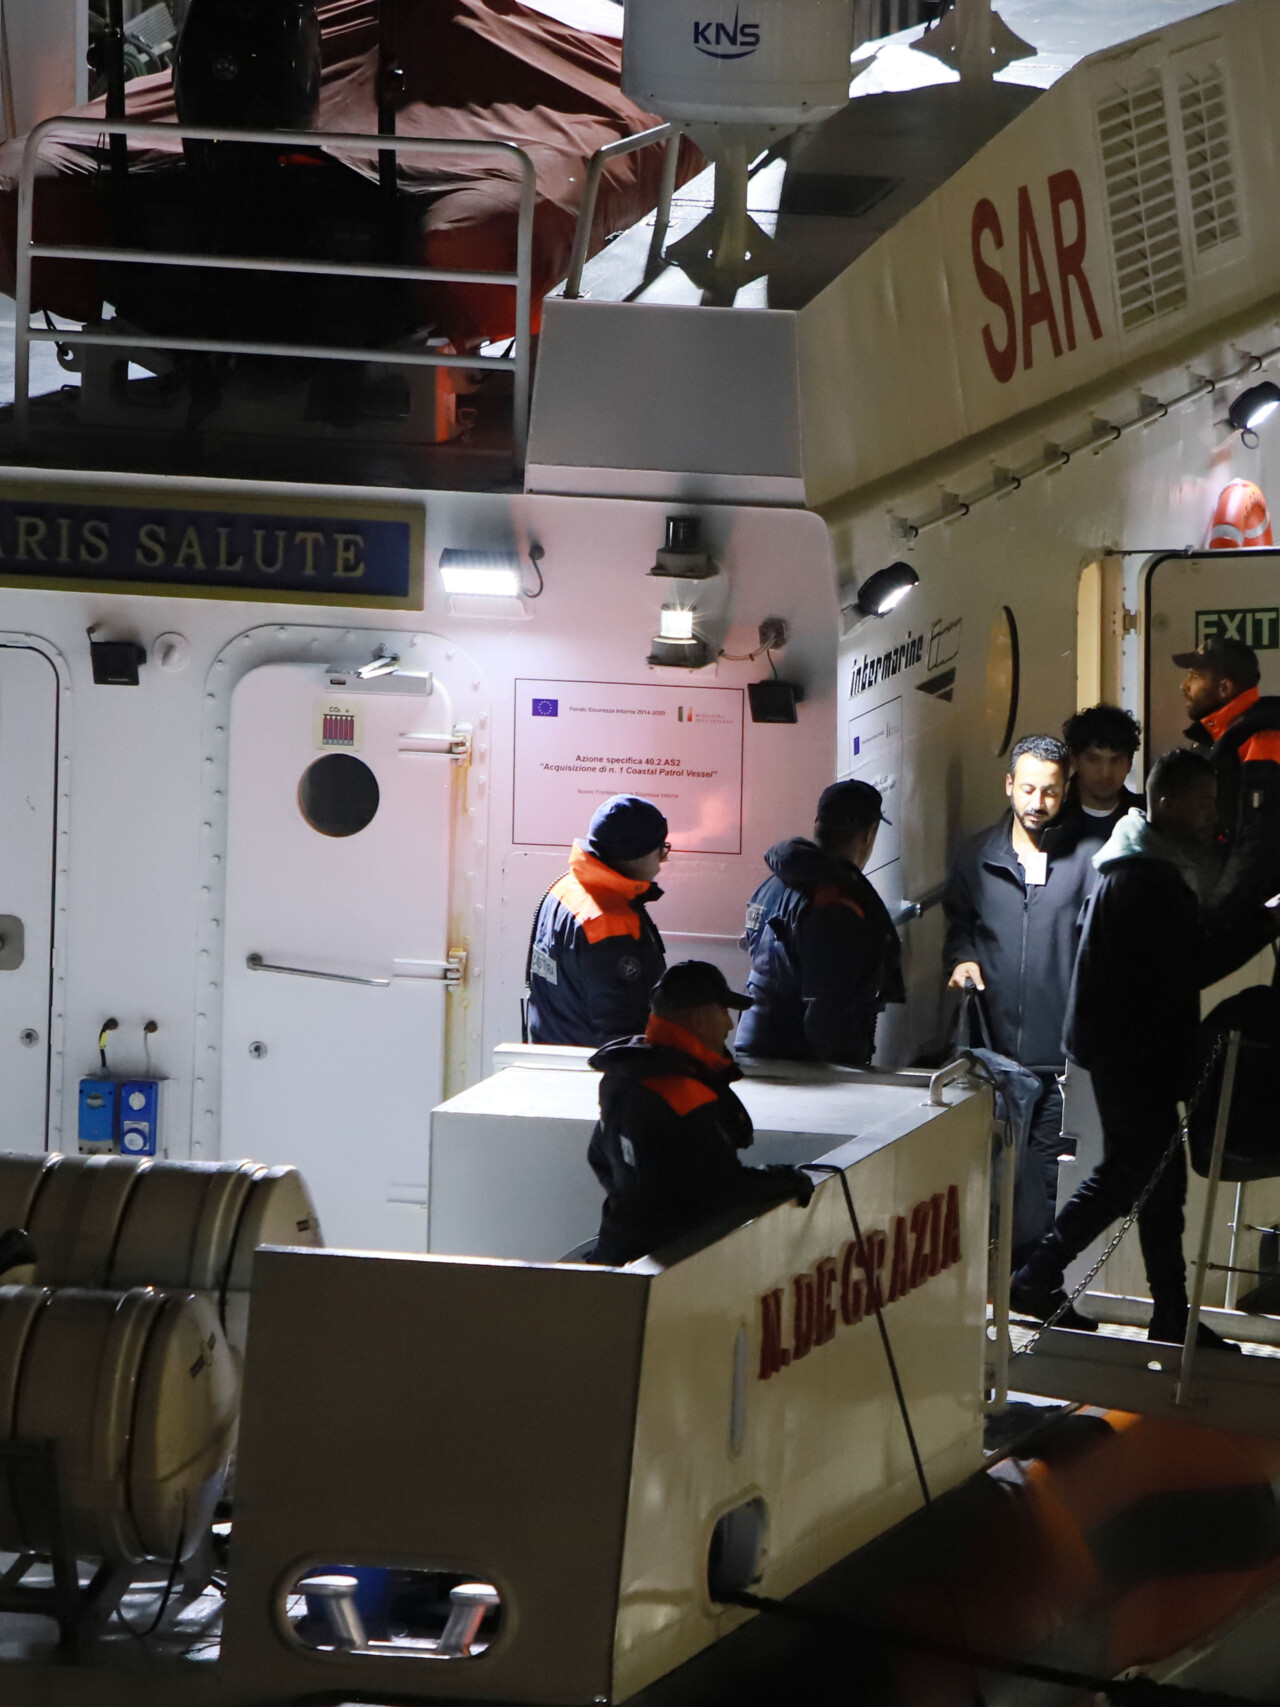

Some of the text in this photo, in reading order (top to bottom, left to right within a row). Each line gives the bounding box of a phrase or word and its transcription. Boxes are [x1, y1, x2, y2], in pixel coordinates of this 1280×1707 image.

[693, 4, 760, 46] KNS
[971, 169, 1103, 383] SAR
[0, 516, 365, 578] RIS SALUTE
[1198, 611, 1277, 646] EXIT
[850, 630, 923, 697] intermarine
[575, 754, 681, 767] Azione specifica 40.2.AS2
[599, 765, 607, 773] di
[619, 766, 624, 774] 1
[626, 766, 657, 776] Coastal
[659, 768, 684, 777] Patrol
